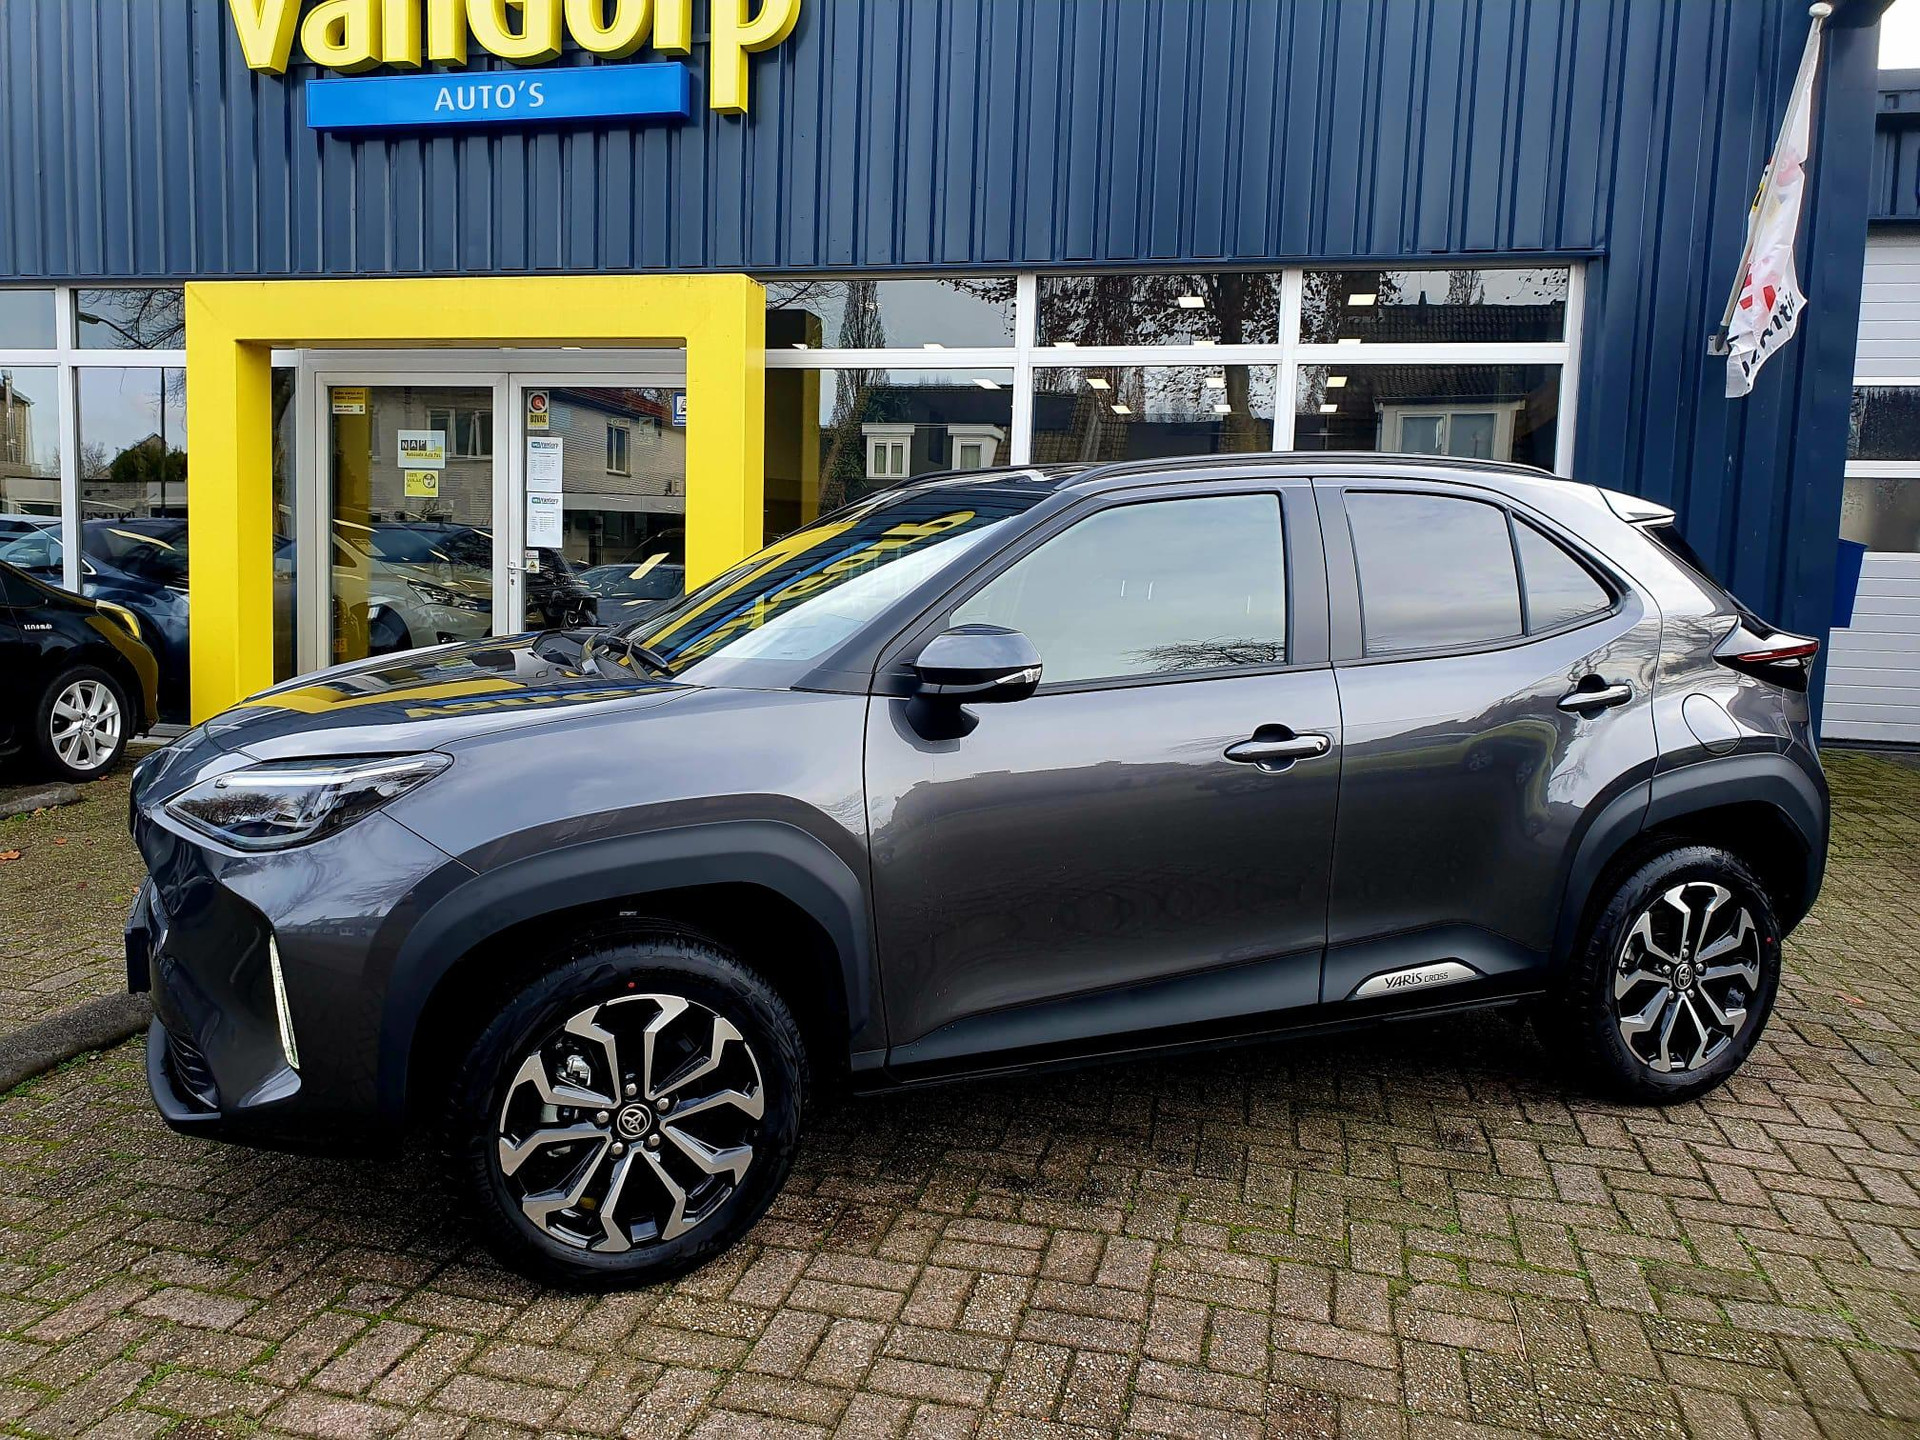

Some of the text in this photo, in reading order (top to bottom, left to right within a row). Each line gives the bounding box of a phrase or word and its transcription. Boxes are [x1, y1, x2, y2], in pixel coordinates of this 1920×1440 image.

[434, 80, 544, 111] AUTO'S
[401, 440, 427, 450] NAP
[1424, 972, 1448, 982] CROSS
